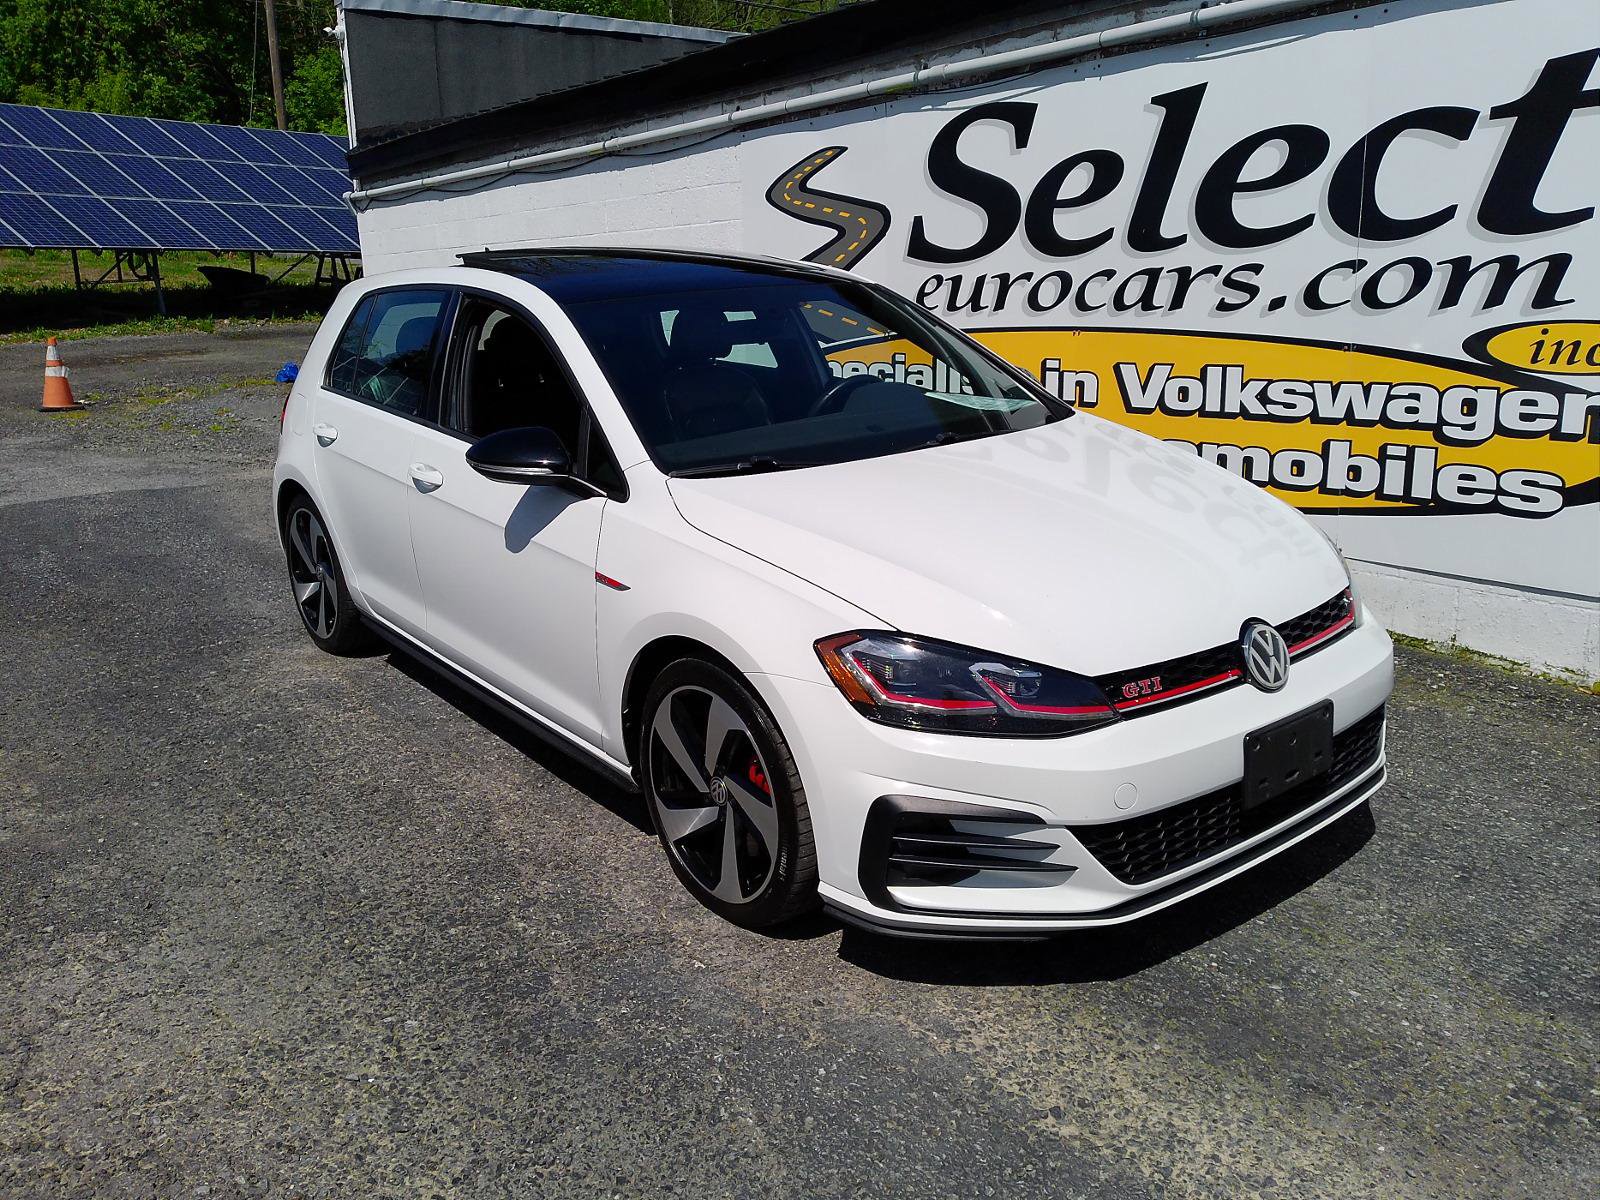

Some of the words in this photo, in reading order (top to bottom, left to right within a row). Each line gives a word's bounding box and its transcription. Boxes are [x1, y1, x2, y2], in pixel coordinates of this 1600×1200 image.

[907, 48, 1600, 263] Select
[916, 252, 1576, 314] eurocars.com
[1041, 359, 1098, 406] in
[1121, 676, 1163, 699] GTI
